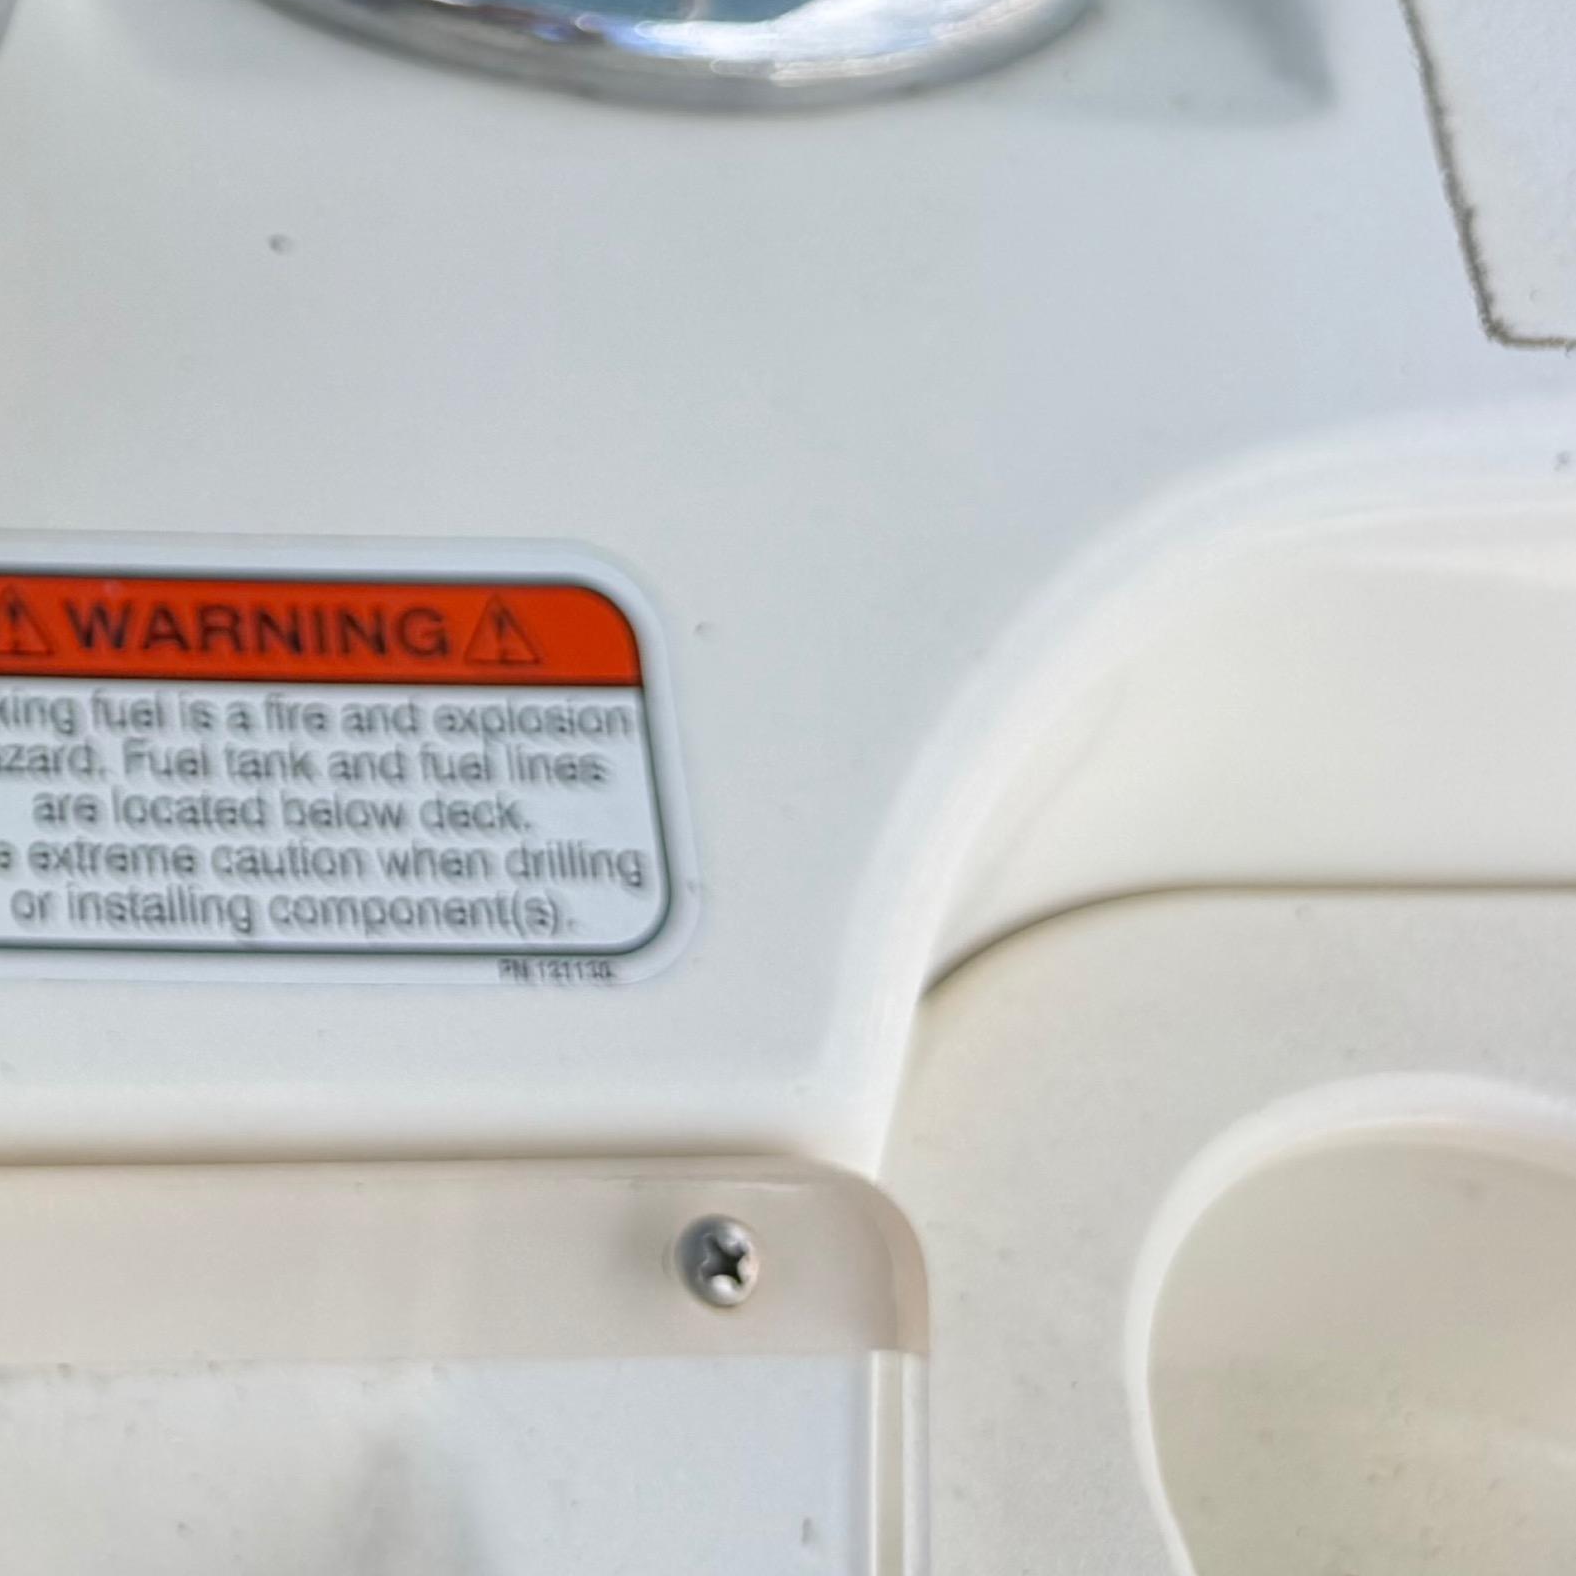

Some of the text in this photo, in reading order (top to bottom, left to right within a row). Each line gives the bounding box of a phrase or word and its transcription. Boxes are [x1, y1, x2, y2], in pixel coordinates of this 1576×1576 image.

[61, 598, 451, 658] WARNING
[90, 688, 167, 730] fuel
[179, 689, 214, 732] is
[225, 699, 253, 732] a
[264, 690, 329, 734] fire
[339, 693, 425, 735] and
[432, 694, 633, 745] explosion
[122, 736, 213, 778] Fuel
[225, 739, 320, 782] tank
[327, 743, 407, 784] and
[419, 741, 496, 783] fuel
[509, 742, 610, 785] lines
[32, 785, 534, 832] are located below deck.
[26, 837, 202, 877] extreme
[211, 839, 366, 879] caution
[380, 838, 494, 880] when
[505, 839, 644, 889] drilling
[10, 880, 579, 938] or installing component(s).
